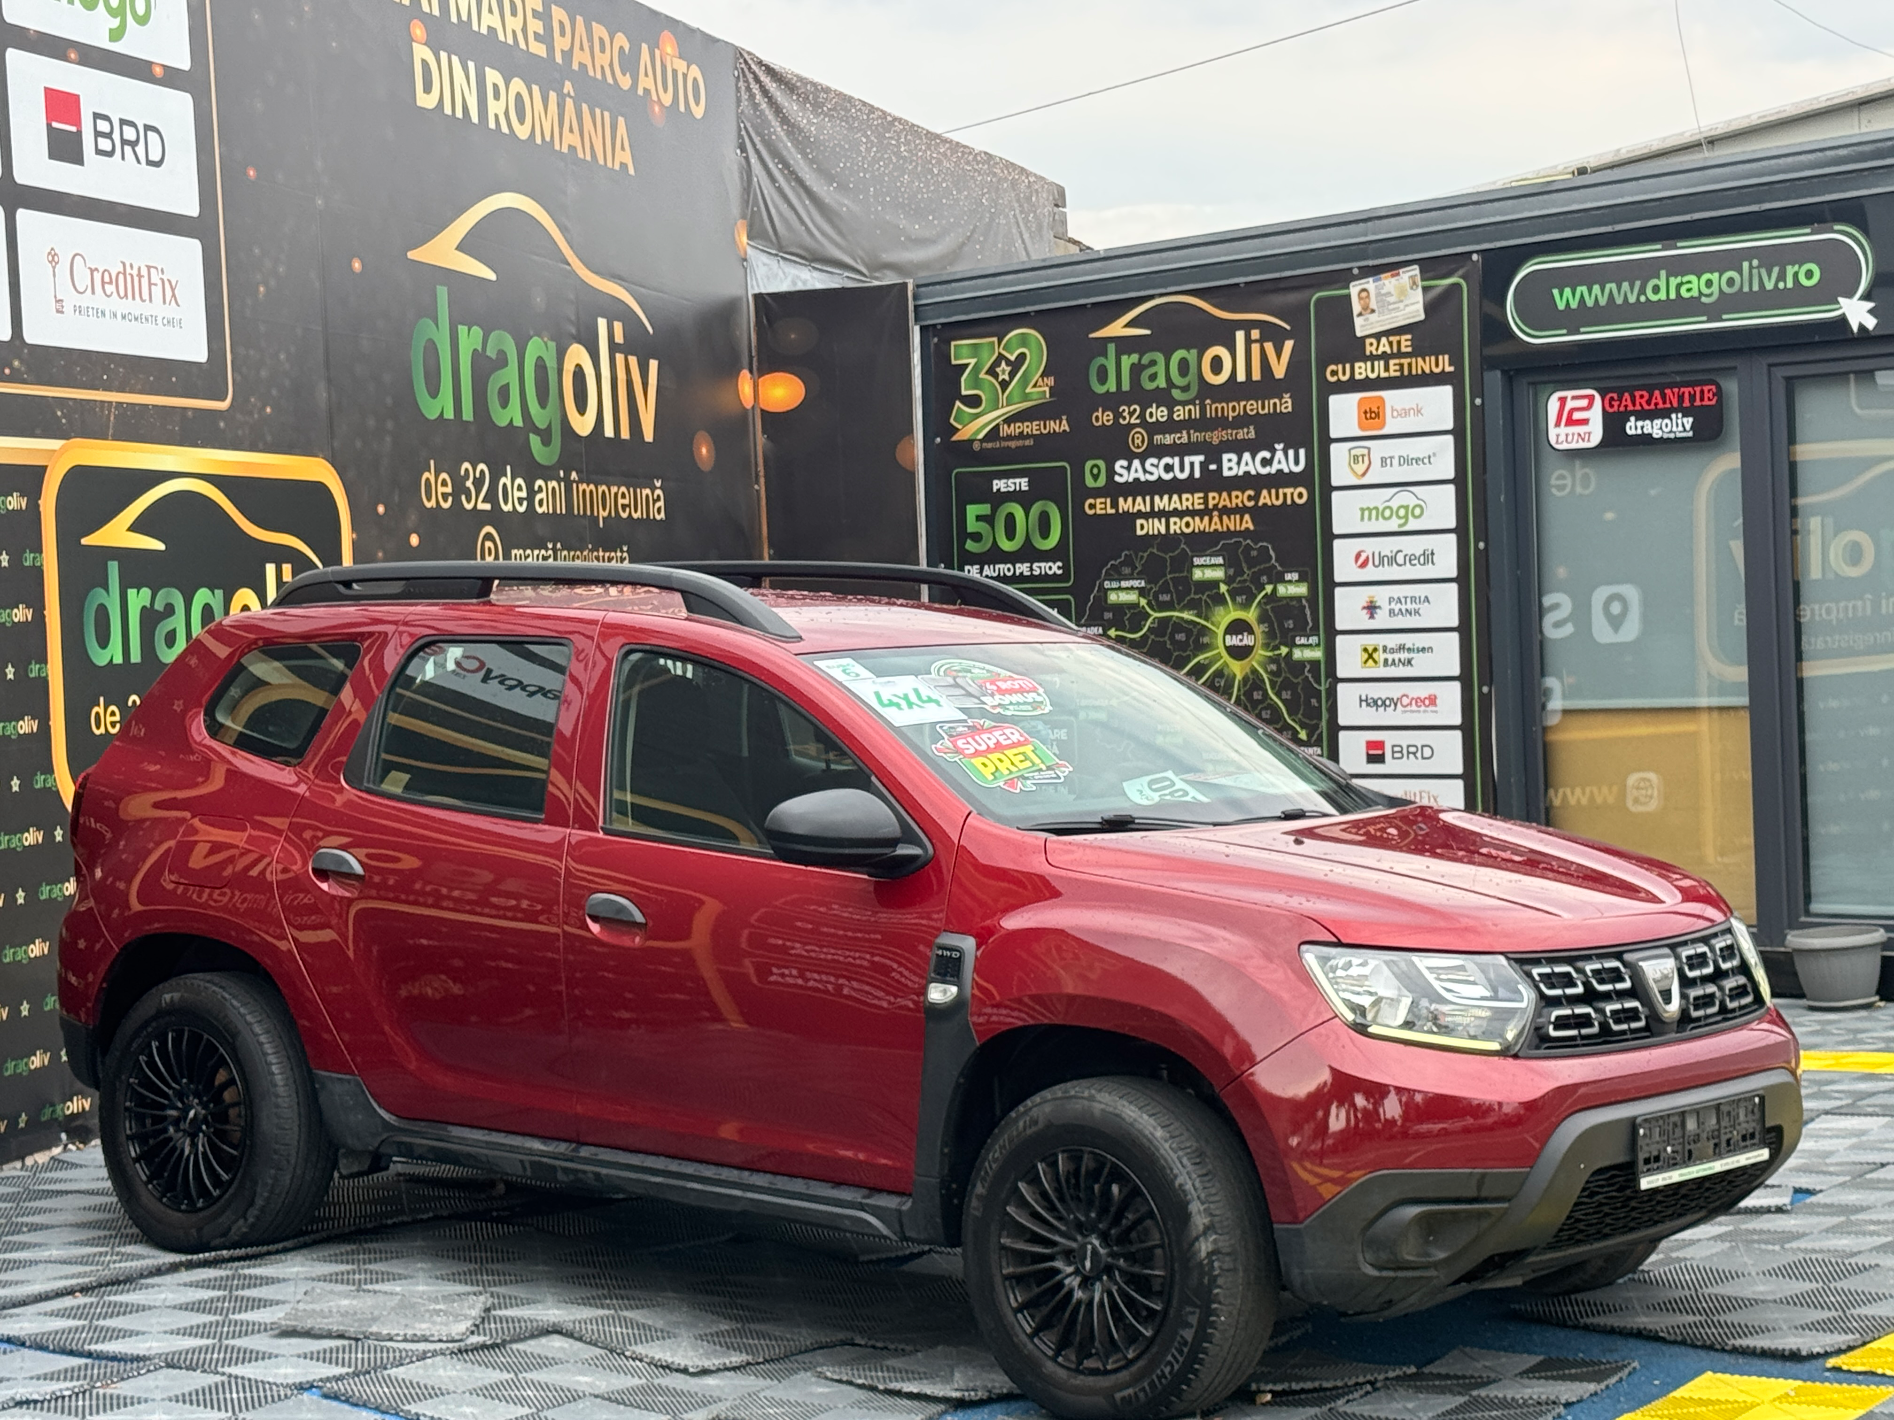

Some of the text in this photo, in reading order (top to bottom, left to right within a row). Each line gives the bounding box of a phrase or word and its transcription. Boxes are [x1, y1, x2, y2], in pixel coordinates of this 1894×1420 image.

[551, 4, 632, 91] PARC
[637, 42, 706, 119] AUTO
[412, 41, 636, 177] DIN ROMÂNIA
[92, 111, 167, 169] BRD
[69, 252, 182, 308] CreditFix
[1551, 258, 1821, 312] www.dragoliv.ro
[73, 304, 184, 330] PRIETEN IN MOMENTE CHEIE
[1364, 334, 1413, 356] RATE
[411, 285, 659, 466] dragoliv
[1087, 329, 1295, 401] dragoliv
[1325, 354, 1455, 383] CU BULETINUL
[1091, 393, 1293, 427] de 32 de ani împreună
[1362, 403, 1424, 421] tbi bank
[1553, 384, 1718, 429] 12 GARANTIE
[1153, 429, 1189, 446] marcă
[1190, 426, 1256, 447] înregistrată
[1554, 412, 1694, 446] LUNI dragoliv
[1114, 455, 1206, 484] SASCUT
[1221, 443, 1307, 478] BACĂU
[1380, 455, 1396, 469] BT
[421, 459, 666, 528] de 32 de ani împreună
[992, 477, 1030, 493] PESTE
[1084, 487, 1309, 516] CEL MAI MARE PARC AUTO
[1359, 502, 1425, 529] mogo
[964, 500, 1063, 553] 500
[1135, 511, 1255, 537] DIN ROMÂNIA
[964, 561, 1063, 577] DE AUTO PE STOC
[1371, 549, 1436, 569] UniCredit
[1388, 595, 1431, 606] PATRIA
[1388, 607, 1422, 618] BANK
[1079, 626, 1104, 635] ADEA
[1382, 656, 1415, 668] BANK
[90, 696, 121, 736] de
[1358, 693, 1438, 713] HappyCredit
[956, 728, 1026, 755] SUPER
[1390, 744, 1435, 761] BRD
[970, 744, 1047, 781] PREȚ
[2, 938, 50, 965] dragoliv
[3, 1048, 51, 1077] dragoliv
[40, 1094, 92, 1123] dragoliv
